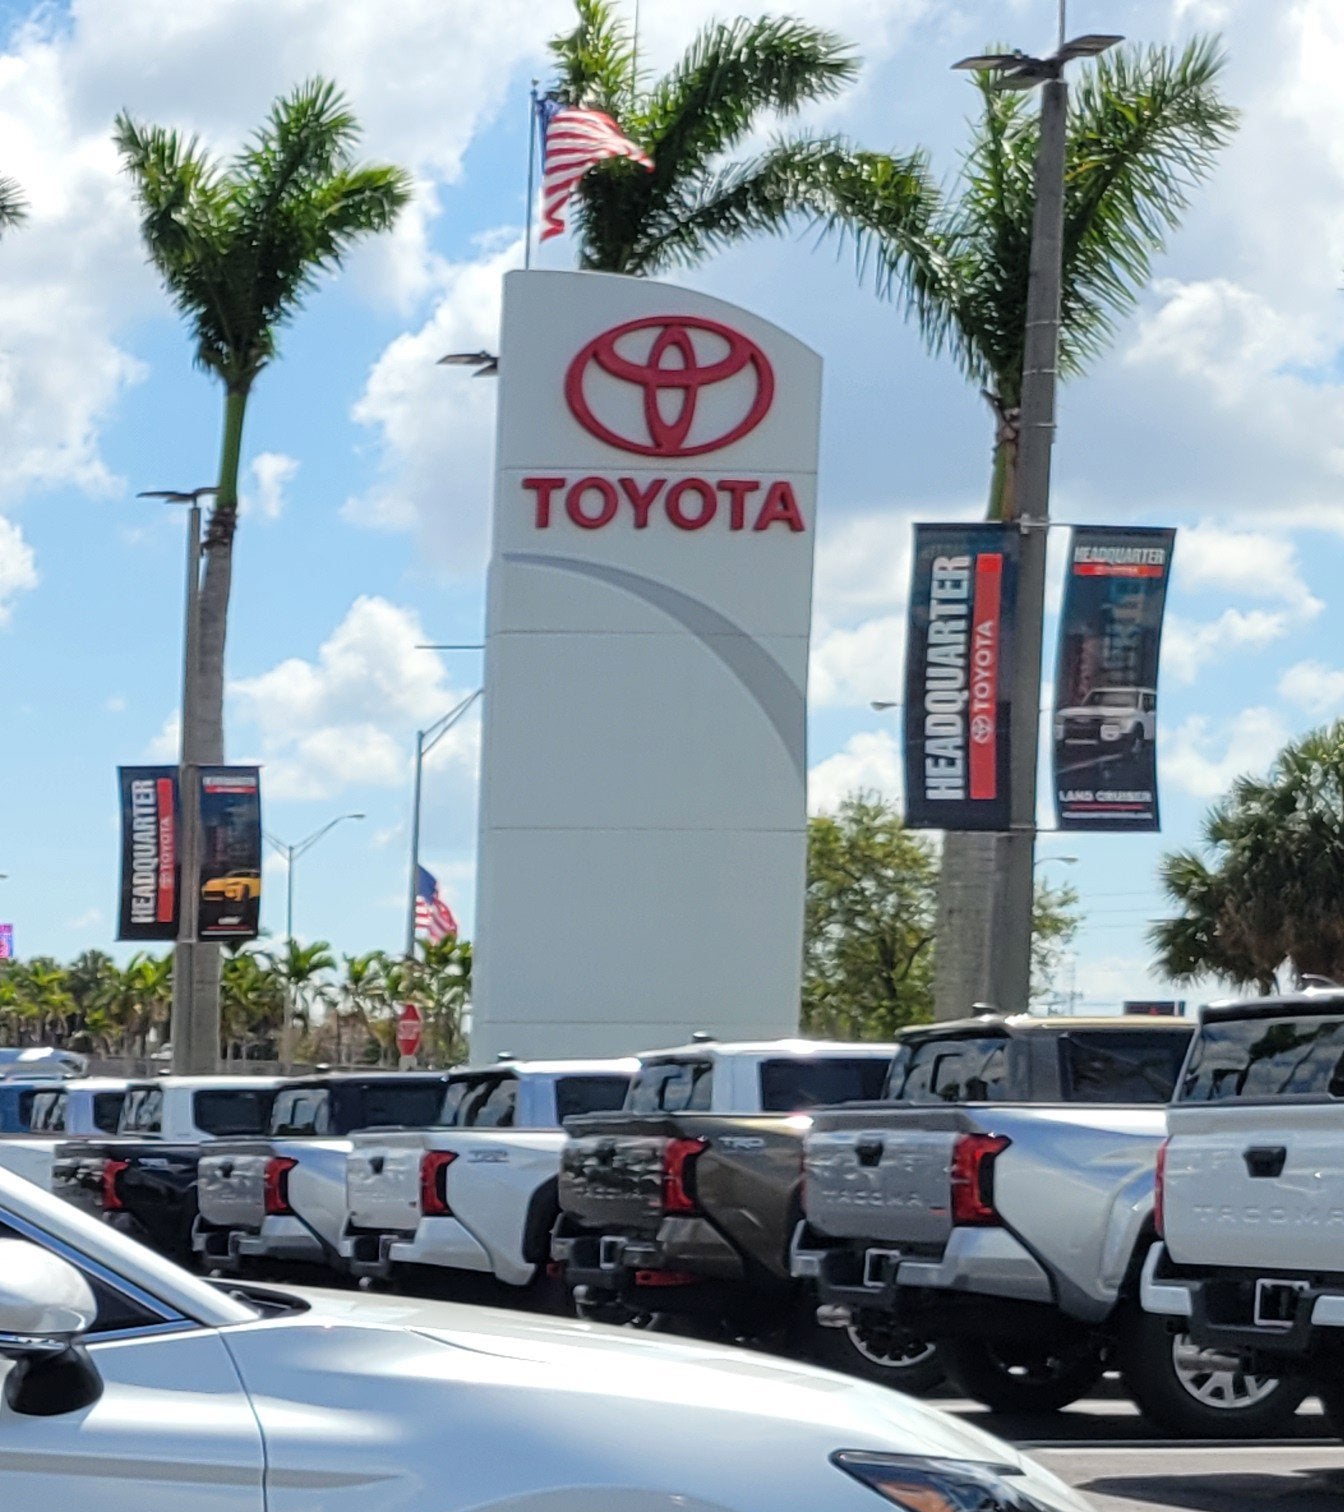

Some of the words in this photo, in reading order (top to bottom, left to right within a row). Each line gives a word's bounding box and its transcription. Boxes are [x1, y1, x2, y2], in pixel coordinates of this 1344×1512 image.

[522, 476, 805, 532] TOYOTA
[1075, 546, 1165, 566] HEADQUARTER
[924, 555, 971, 800] HEADQUARTER
[973, 620, 995, 711] TOYOTA
[1059, 790, 1094, 802] LAND
[131, 779, 159, 924] HEADQUARTER
